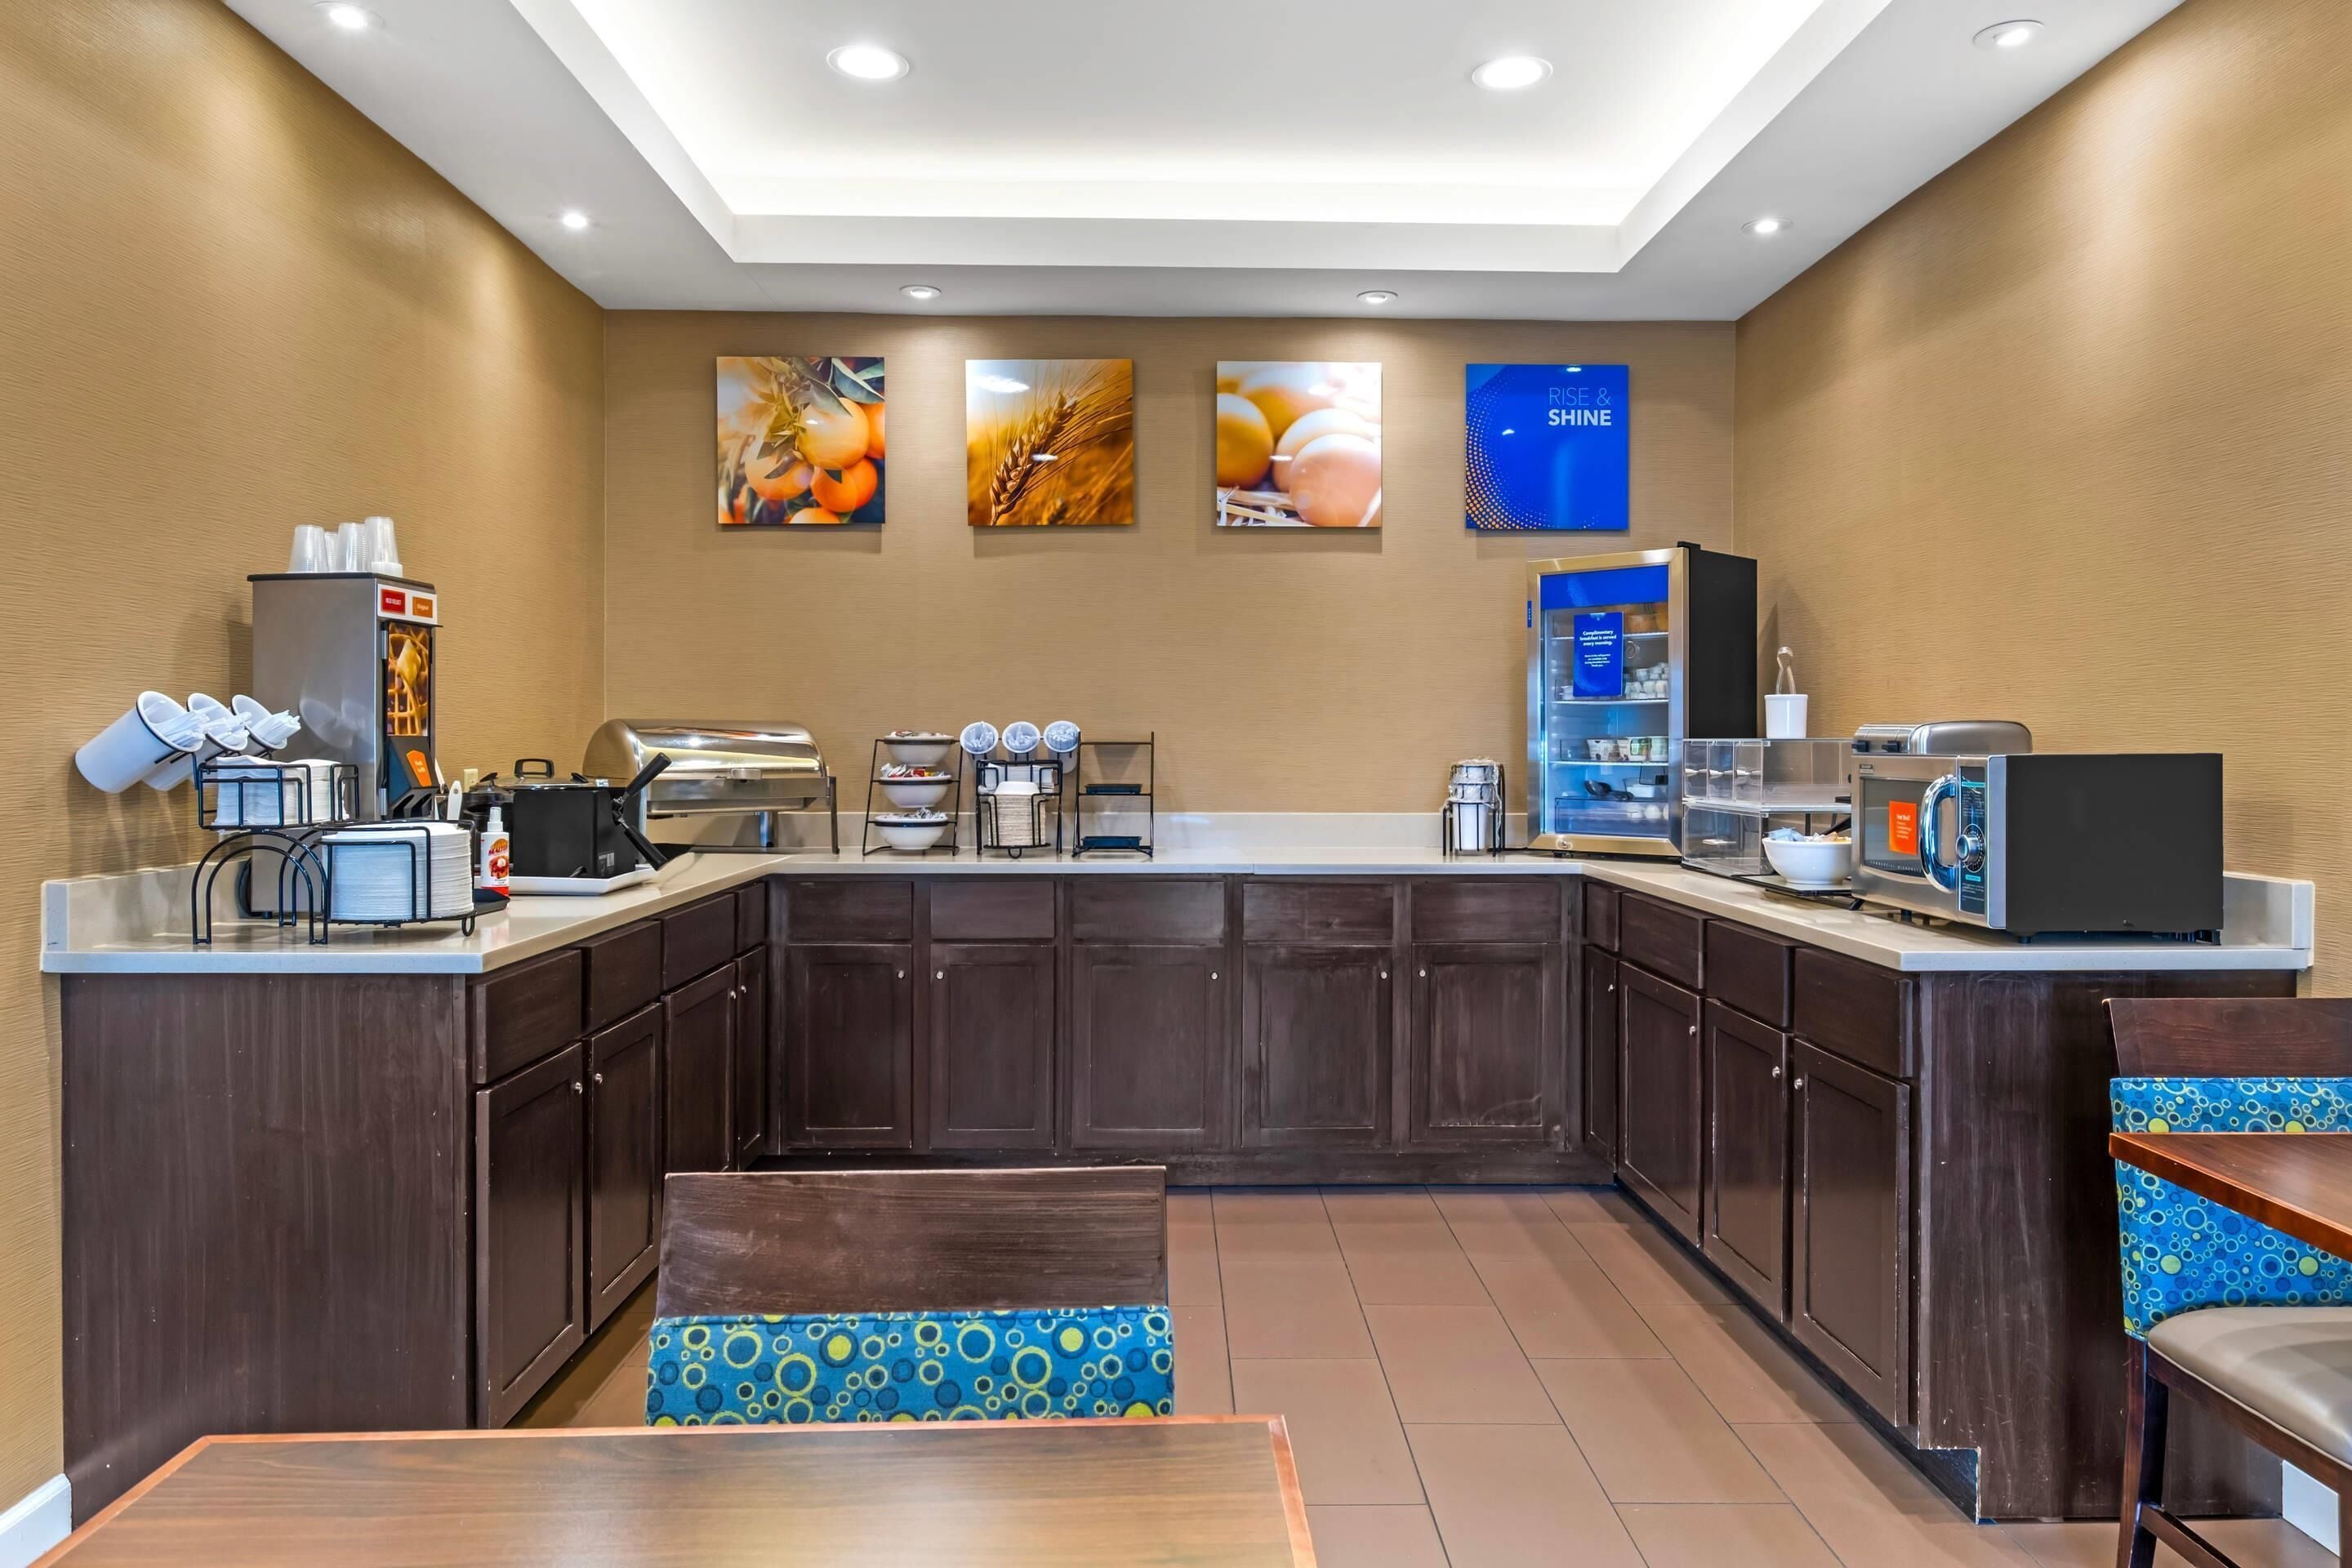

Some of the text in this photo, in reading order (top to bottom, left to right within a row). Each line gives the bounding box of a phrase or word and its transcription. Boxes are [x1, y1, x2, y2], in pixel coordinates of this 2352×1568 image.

[1549, 387, 1611, 406] RISE &
[1548, 408, 1612, 426] SHINE
